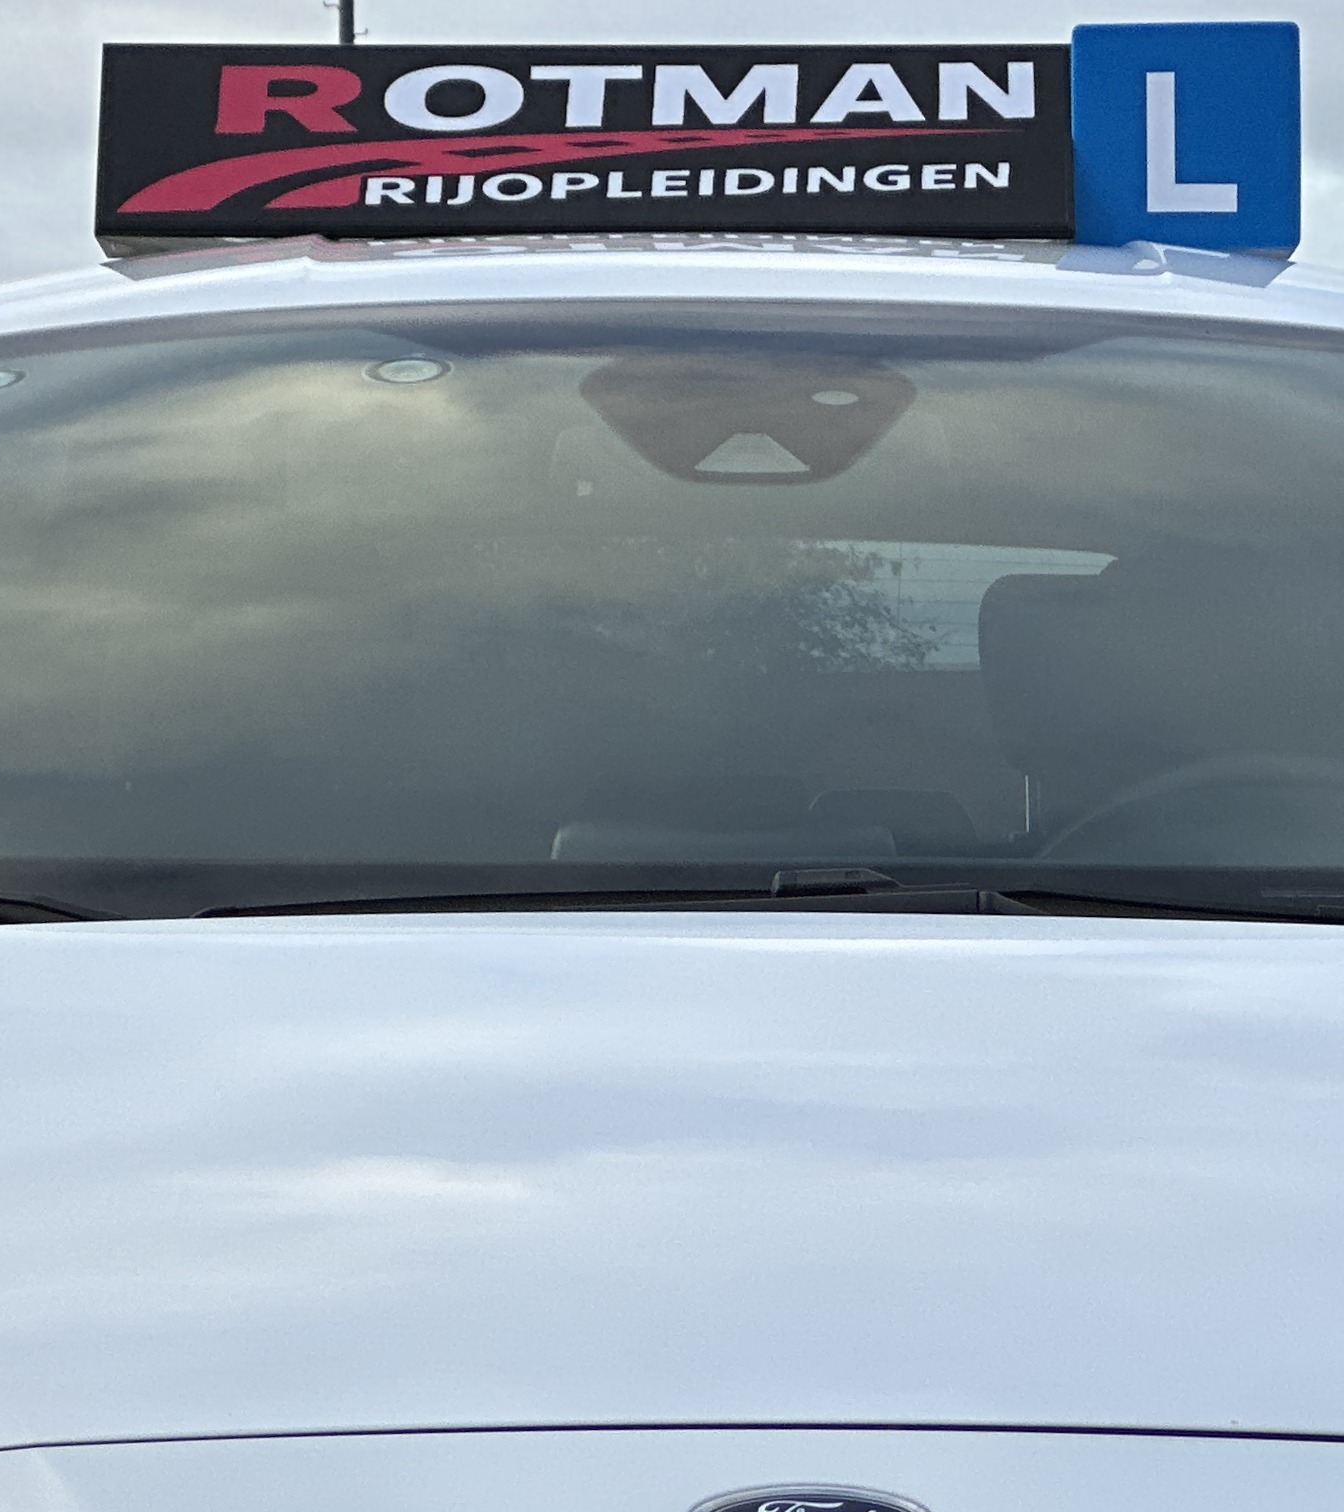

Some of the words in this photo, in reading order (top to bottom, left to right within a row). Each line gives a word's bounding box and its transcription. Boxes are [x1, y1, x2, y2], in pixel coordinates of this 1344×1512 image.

[214, 61, 1036, 135] ROTMAN
[1146, 71, 1238, 213] L
[364, 161, 1011, 206] RIJOPLEIDINGEN
